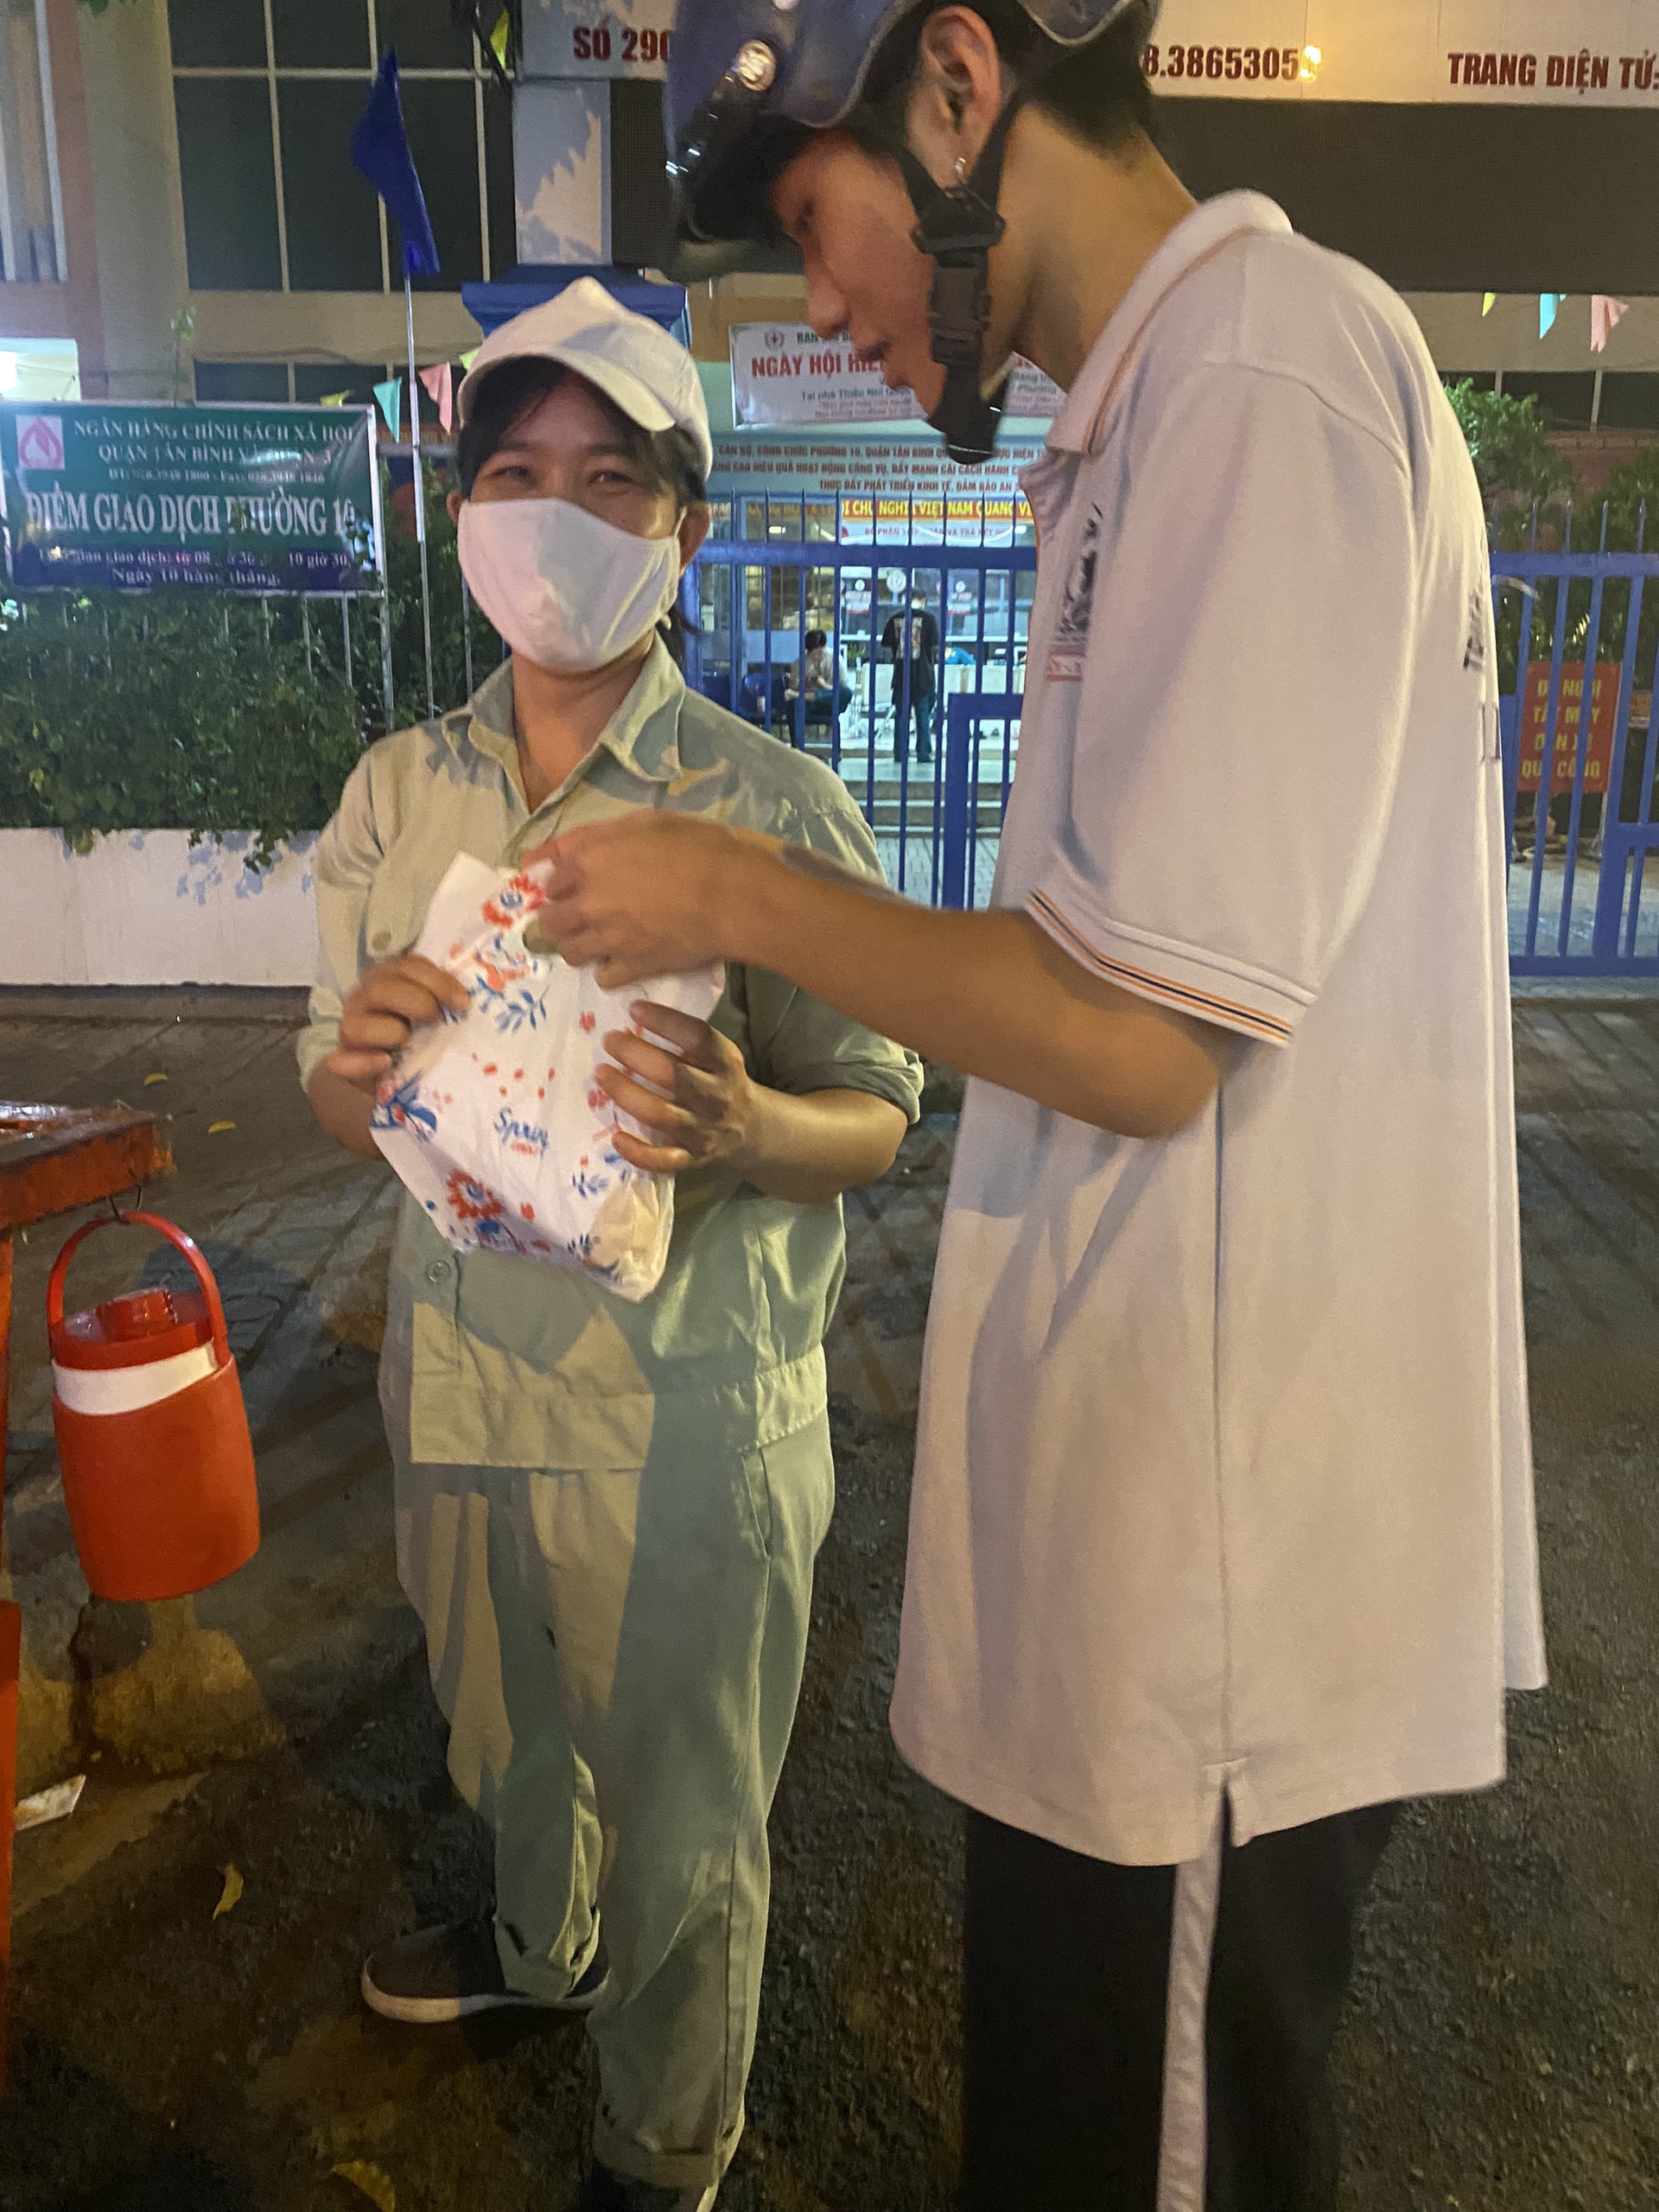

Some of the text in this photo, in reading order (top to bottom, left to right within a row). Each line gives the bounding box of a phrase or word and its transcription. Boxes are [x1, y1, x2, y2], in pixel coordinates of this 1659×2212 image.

[1142, 45, 1322, 81] 8.3865305
[1448, 53, 1537, 86] TRANG
[752, 349, 802, 378] NGÀY
[809, 348, 841, 378] HỘI
[74, 416, 122, 436] NGÂN
[129, 418, 178, 439] HÀNG
[182, 420, 238, 441] CHÍNH
[243, 422, 289, 442] SÁCH
[99, 443, 147, 464] QUẬN
[154, 442, 187, 462] TÂN
[193, 442, 233, 462] BÌNH
[712, 460, 731, 473] ÂNG
[917, 480, 938, 492] KINH
[1000, 480, 1012, 492] AN
[27, 480, 91, 531] ĐIỂM
[93, 493, 156, 533] GIAO
[158, 493, 221, 544] DỊCH
[947, 500, 973, 516] NAM
[1020, 500, 1033, 516] VI
[1565, 706, 1600, 723] MY
[1522, 760, 1543, 778] QU
